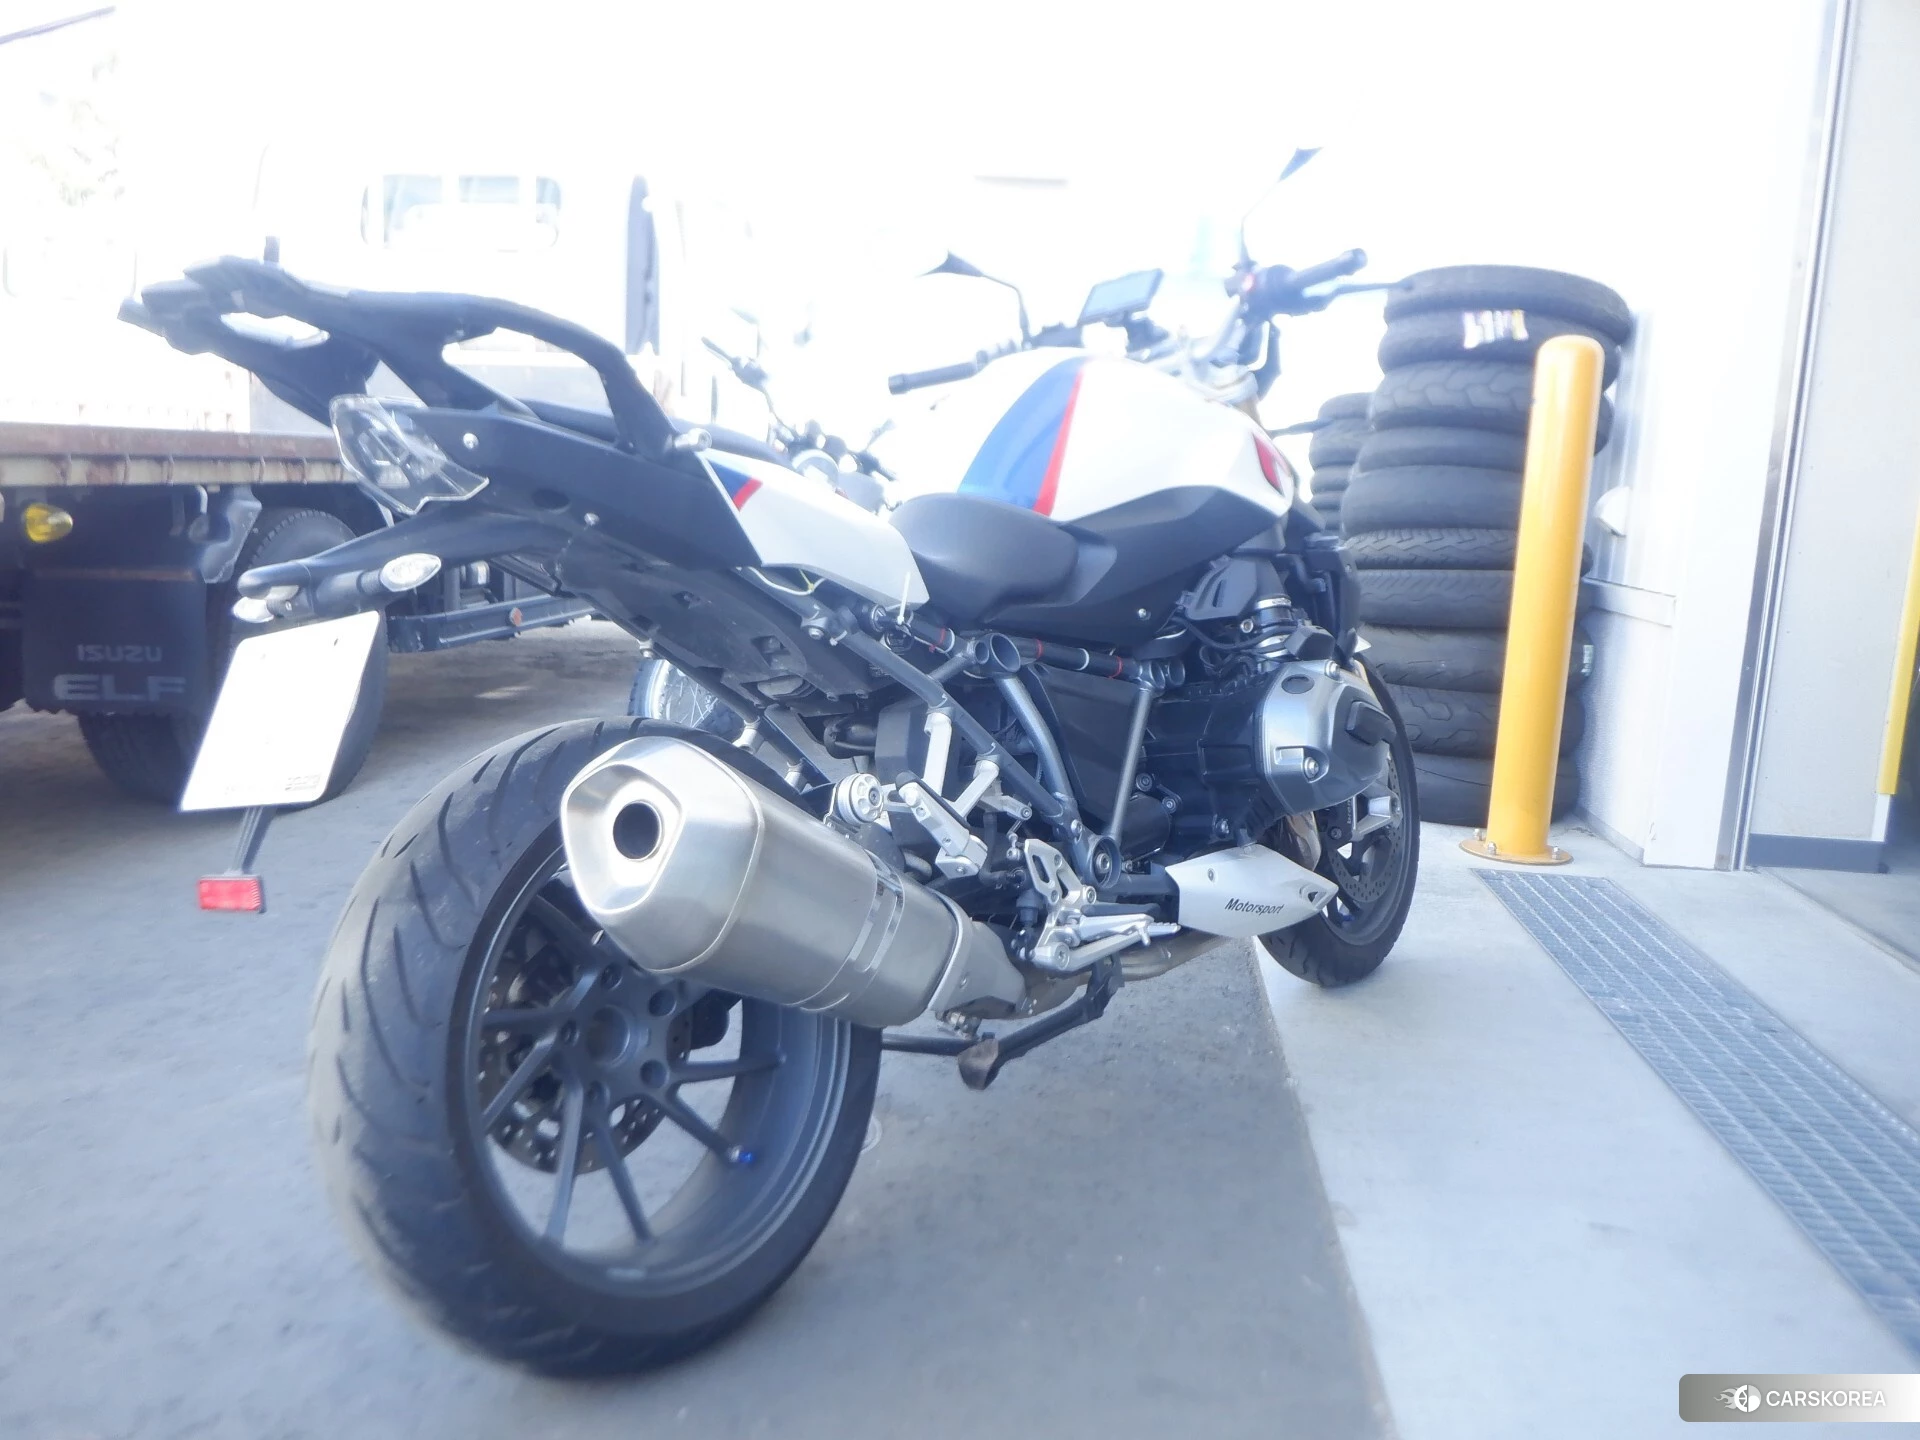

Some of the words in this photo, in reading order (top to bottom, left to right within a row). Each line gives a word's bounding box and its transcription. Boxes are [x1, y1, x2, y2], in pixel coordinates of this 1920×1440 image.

[77, 644, 162, 662] ISUZU
[54, 674, 186, 701] ELF
[1225, 898, 1285, 916] Motorsport
